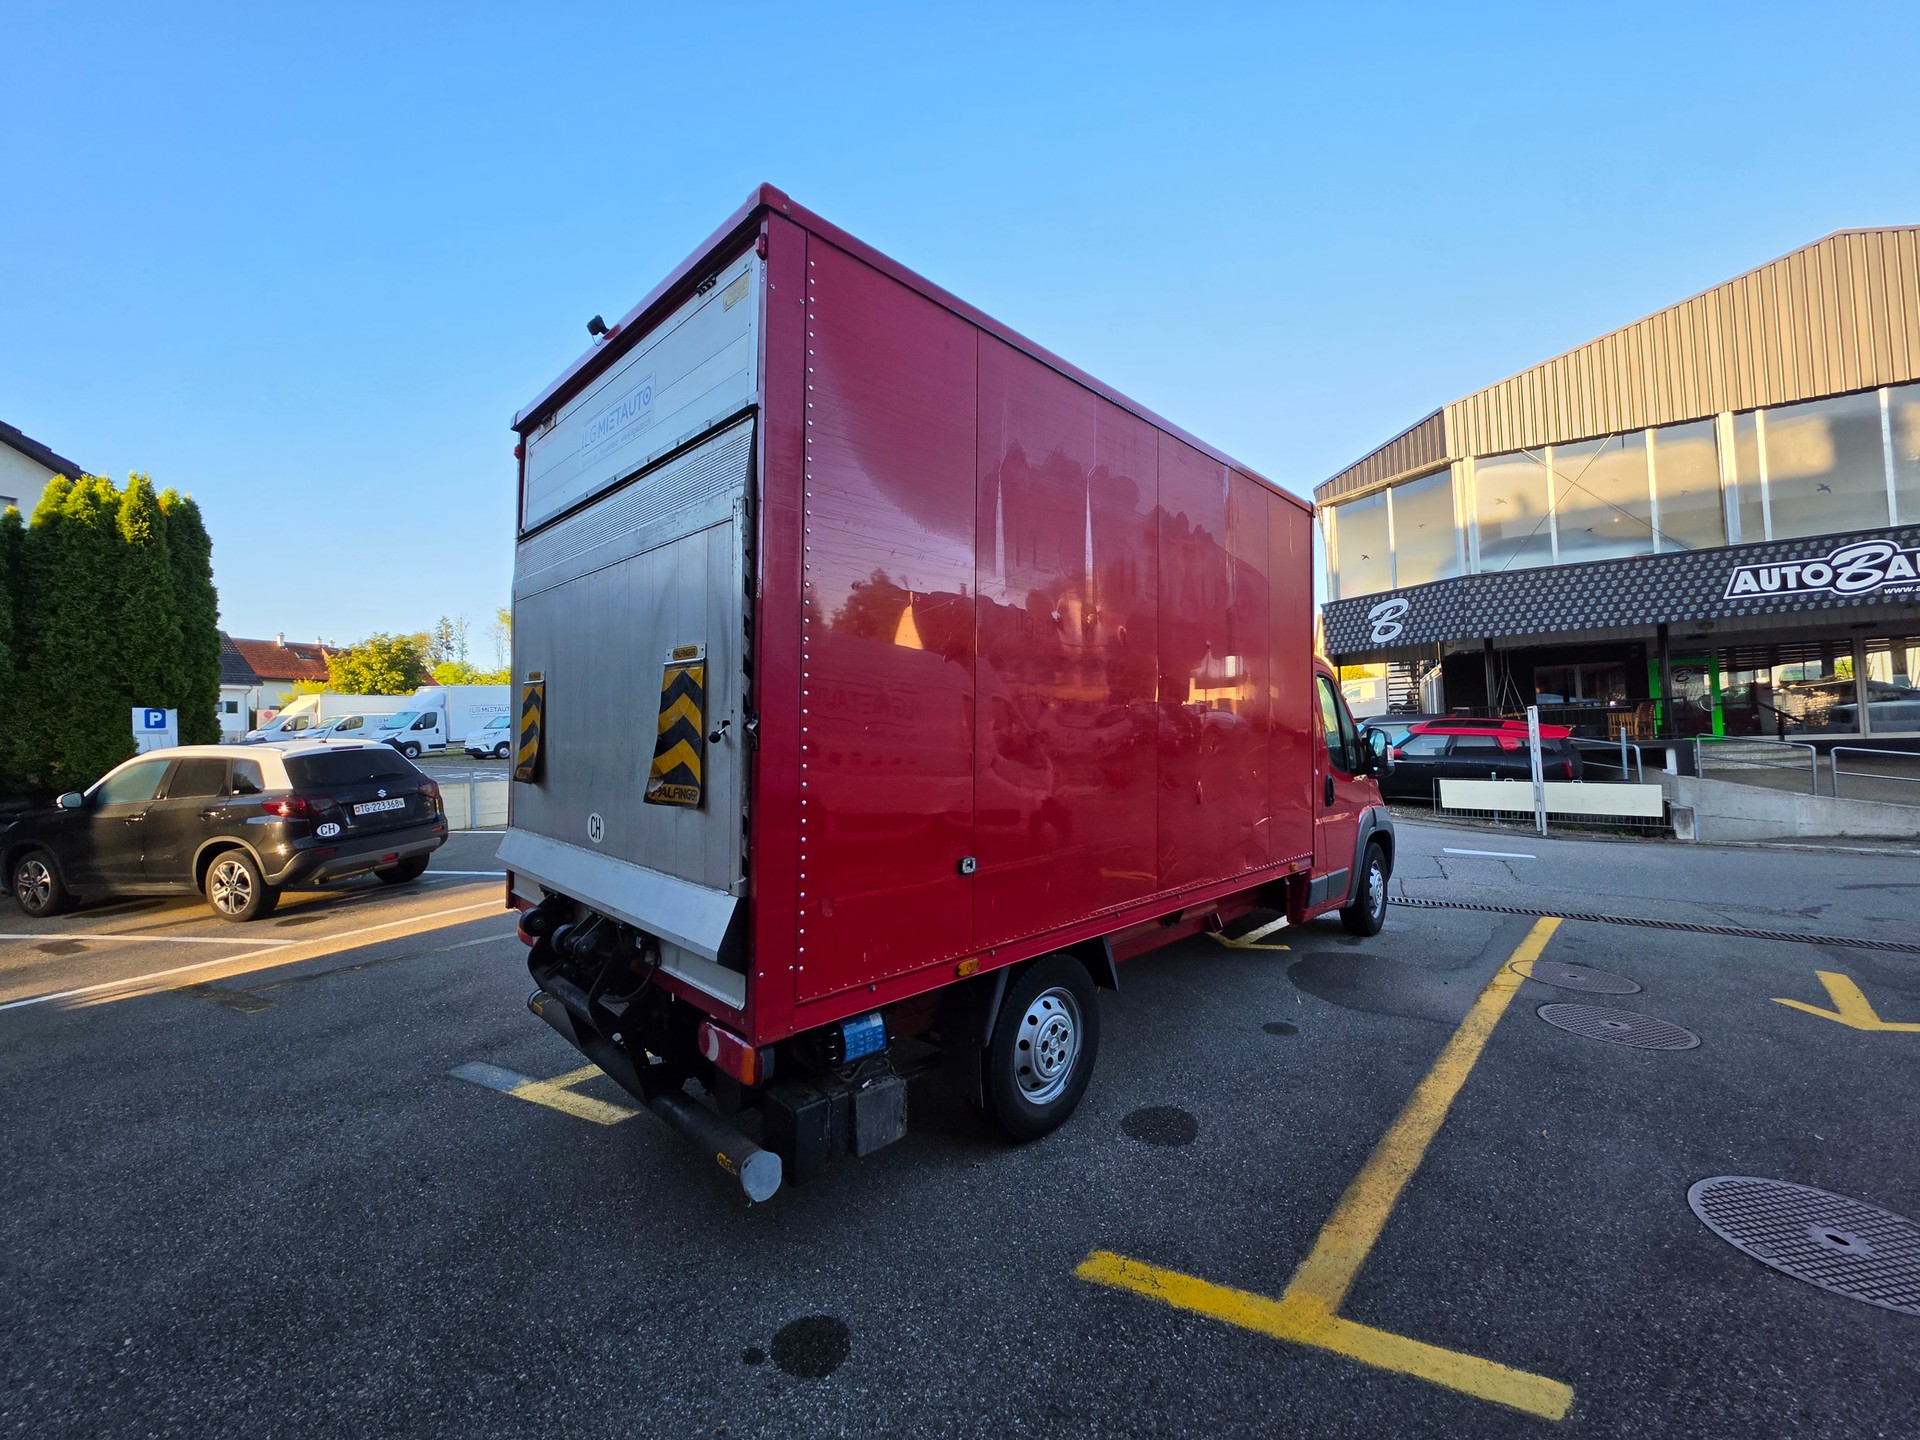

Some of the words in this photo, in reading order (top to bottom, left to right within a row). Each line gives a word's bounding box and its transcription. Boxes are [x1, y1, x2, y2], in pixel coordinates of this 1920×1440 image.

[581, 424, 597, 450] ILG
[597, 385, 652, 439] MIETAUTO
[1732, 544, 1920, 594] AUTOBA
[1367, 597, 1409, 643] B
[149, 711, 162, 726] P
[320, 824, 336, 836] CH
[590, 815, 601, 840] CH
